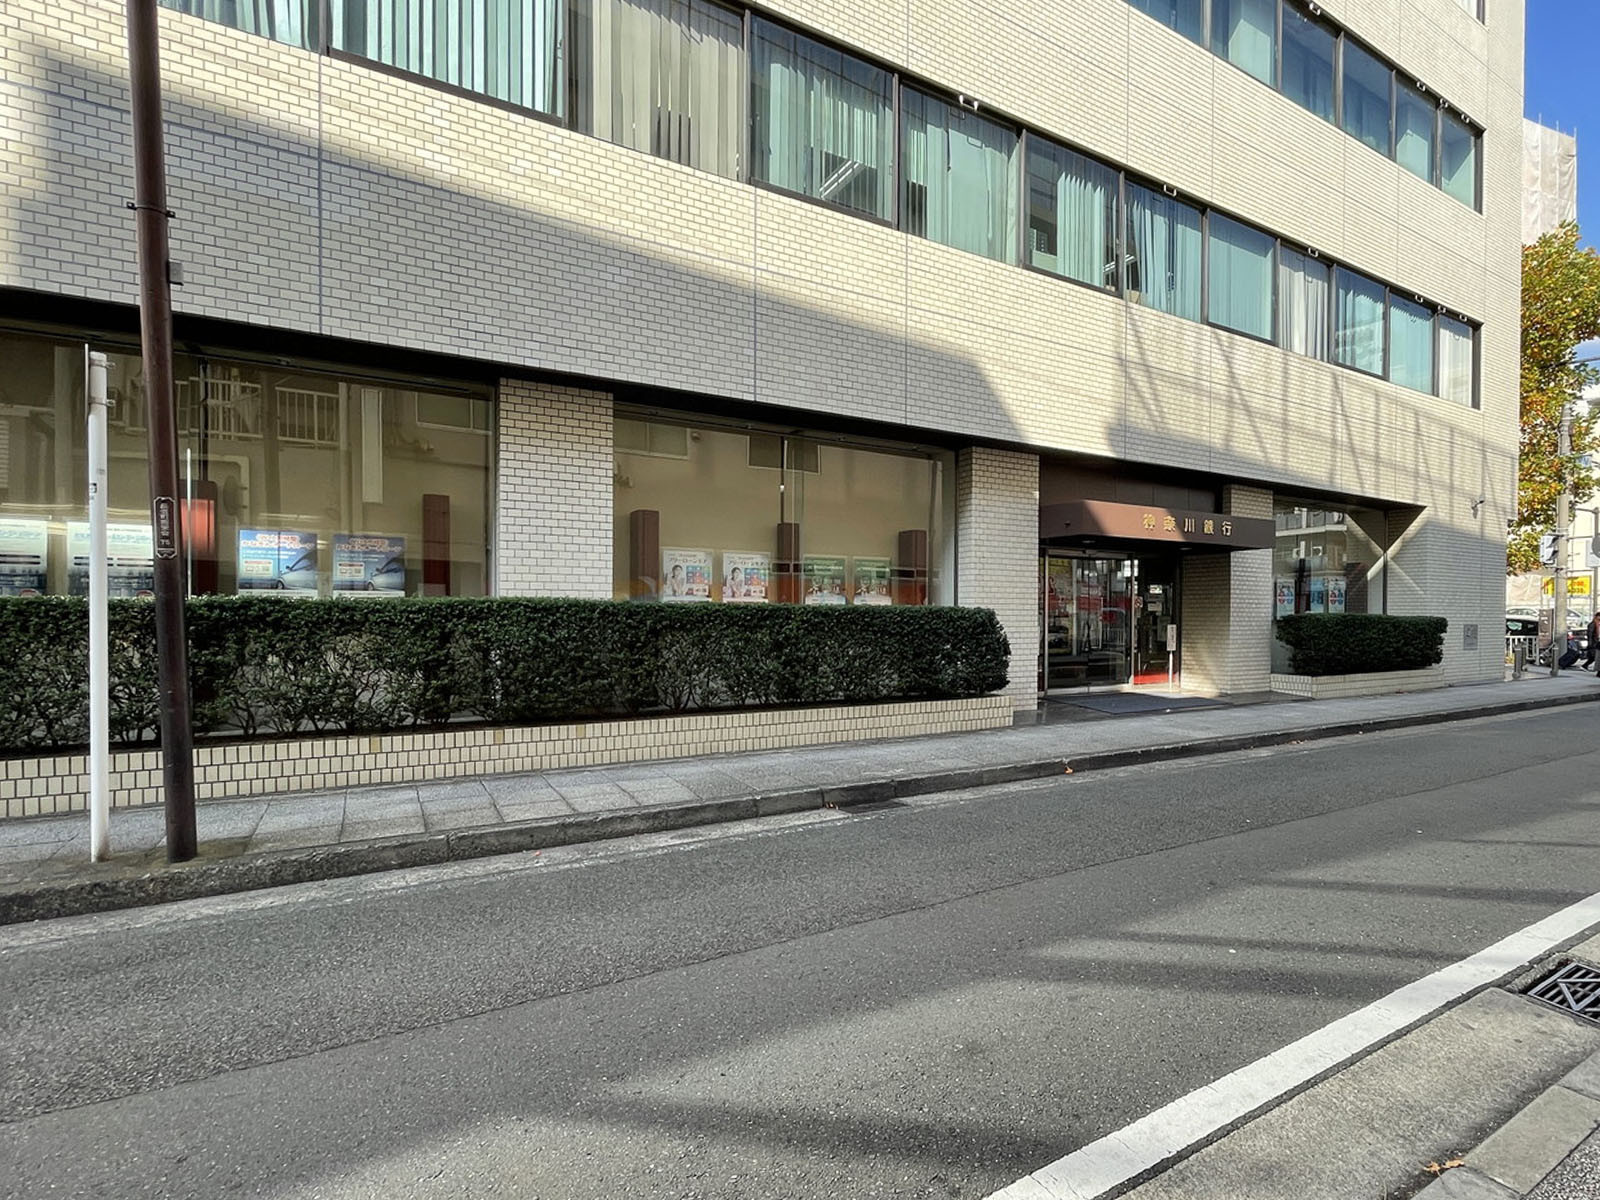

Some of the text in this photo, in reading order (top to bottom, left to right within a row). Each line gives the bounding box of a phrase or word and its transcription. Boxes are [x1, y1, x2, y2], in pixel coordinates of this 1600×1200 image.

[1142, 513, 1232, 536] 神奈川銀行
